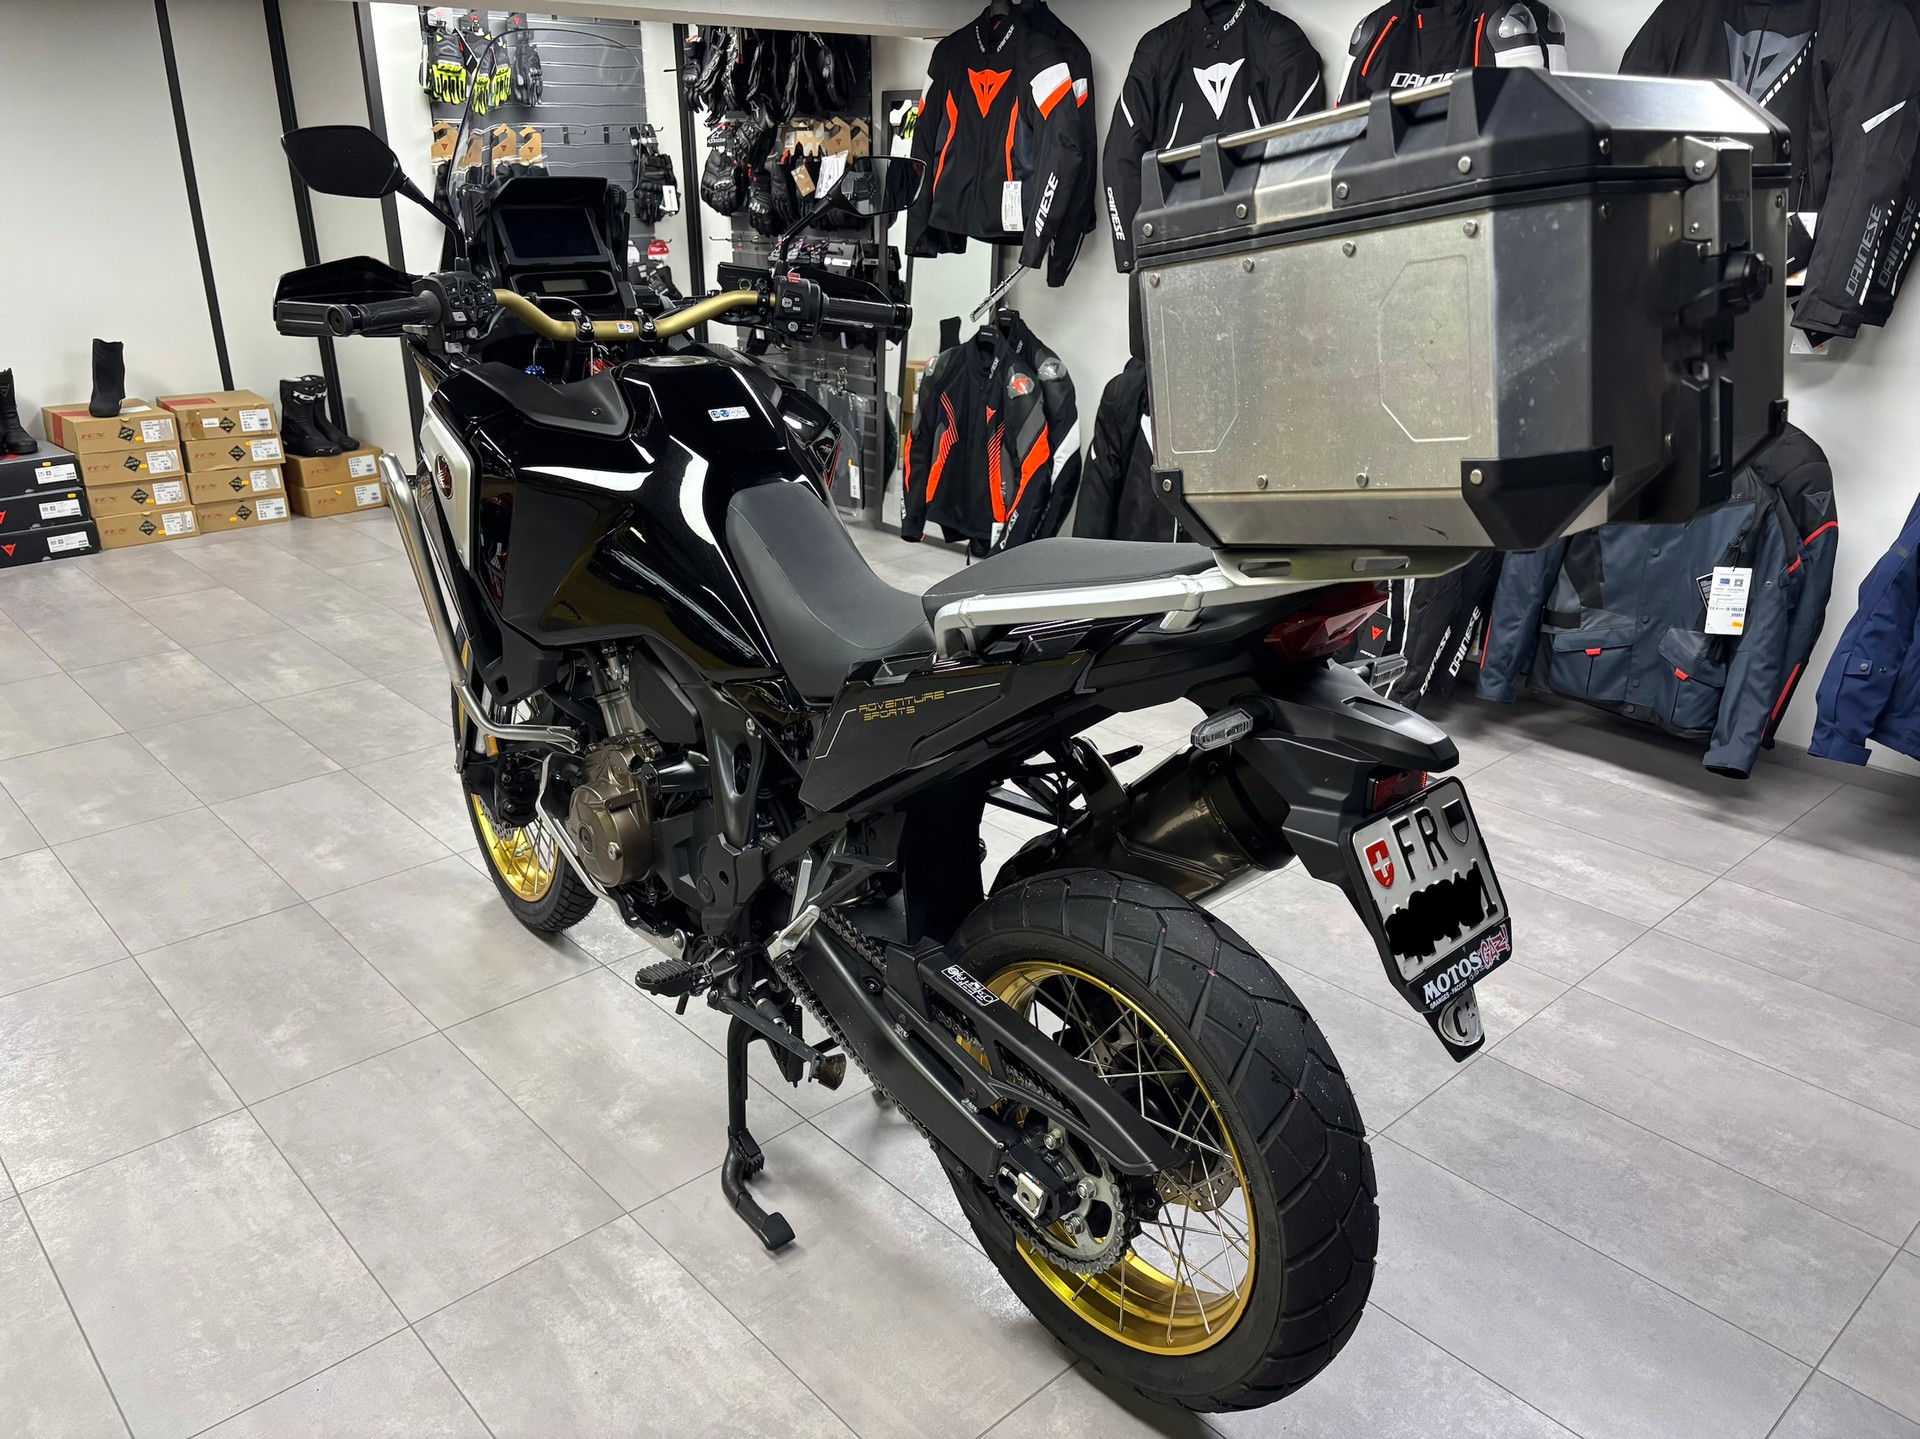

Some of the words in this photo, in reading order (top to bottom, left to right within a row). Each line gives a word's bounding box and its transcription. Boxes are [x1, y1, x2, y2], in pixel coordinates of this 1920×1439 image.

[1107, 186, 1126, 241] DAINESE
[1845, 203, 1882, 297] DAINESE
[1877, 196, 1917, 289] DAINESE
[1448, 605, 1482, 678] DAINESE
[858, 690, 945, 713] ADVENTURE
[863, 705, 916, 723] SPORTS
[1391, 806, 1449, 883] FR
